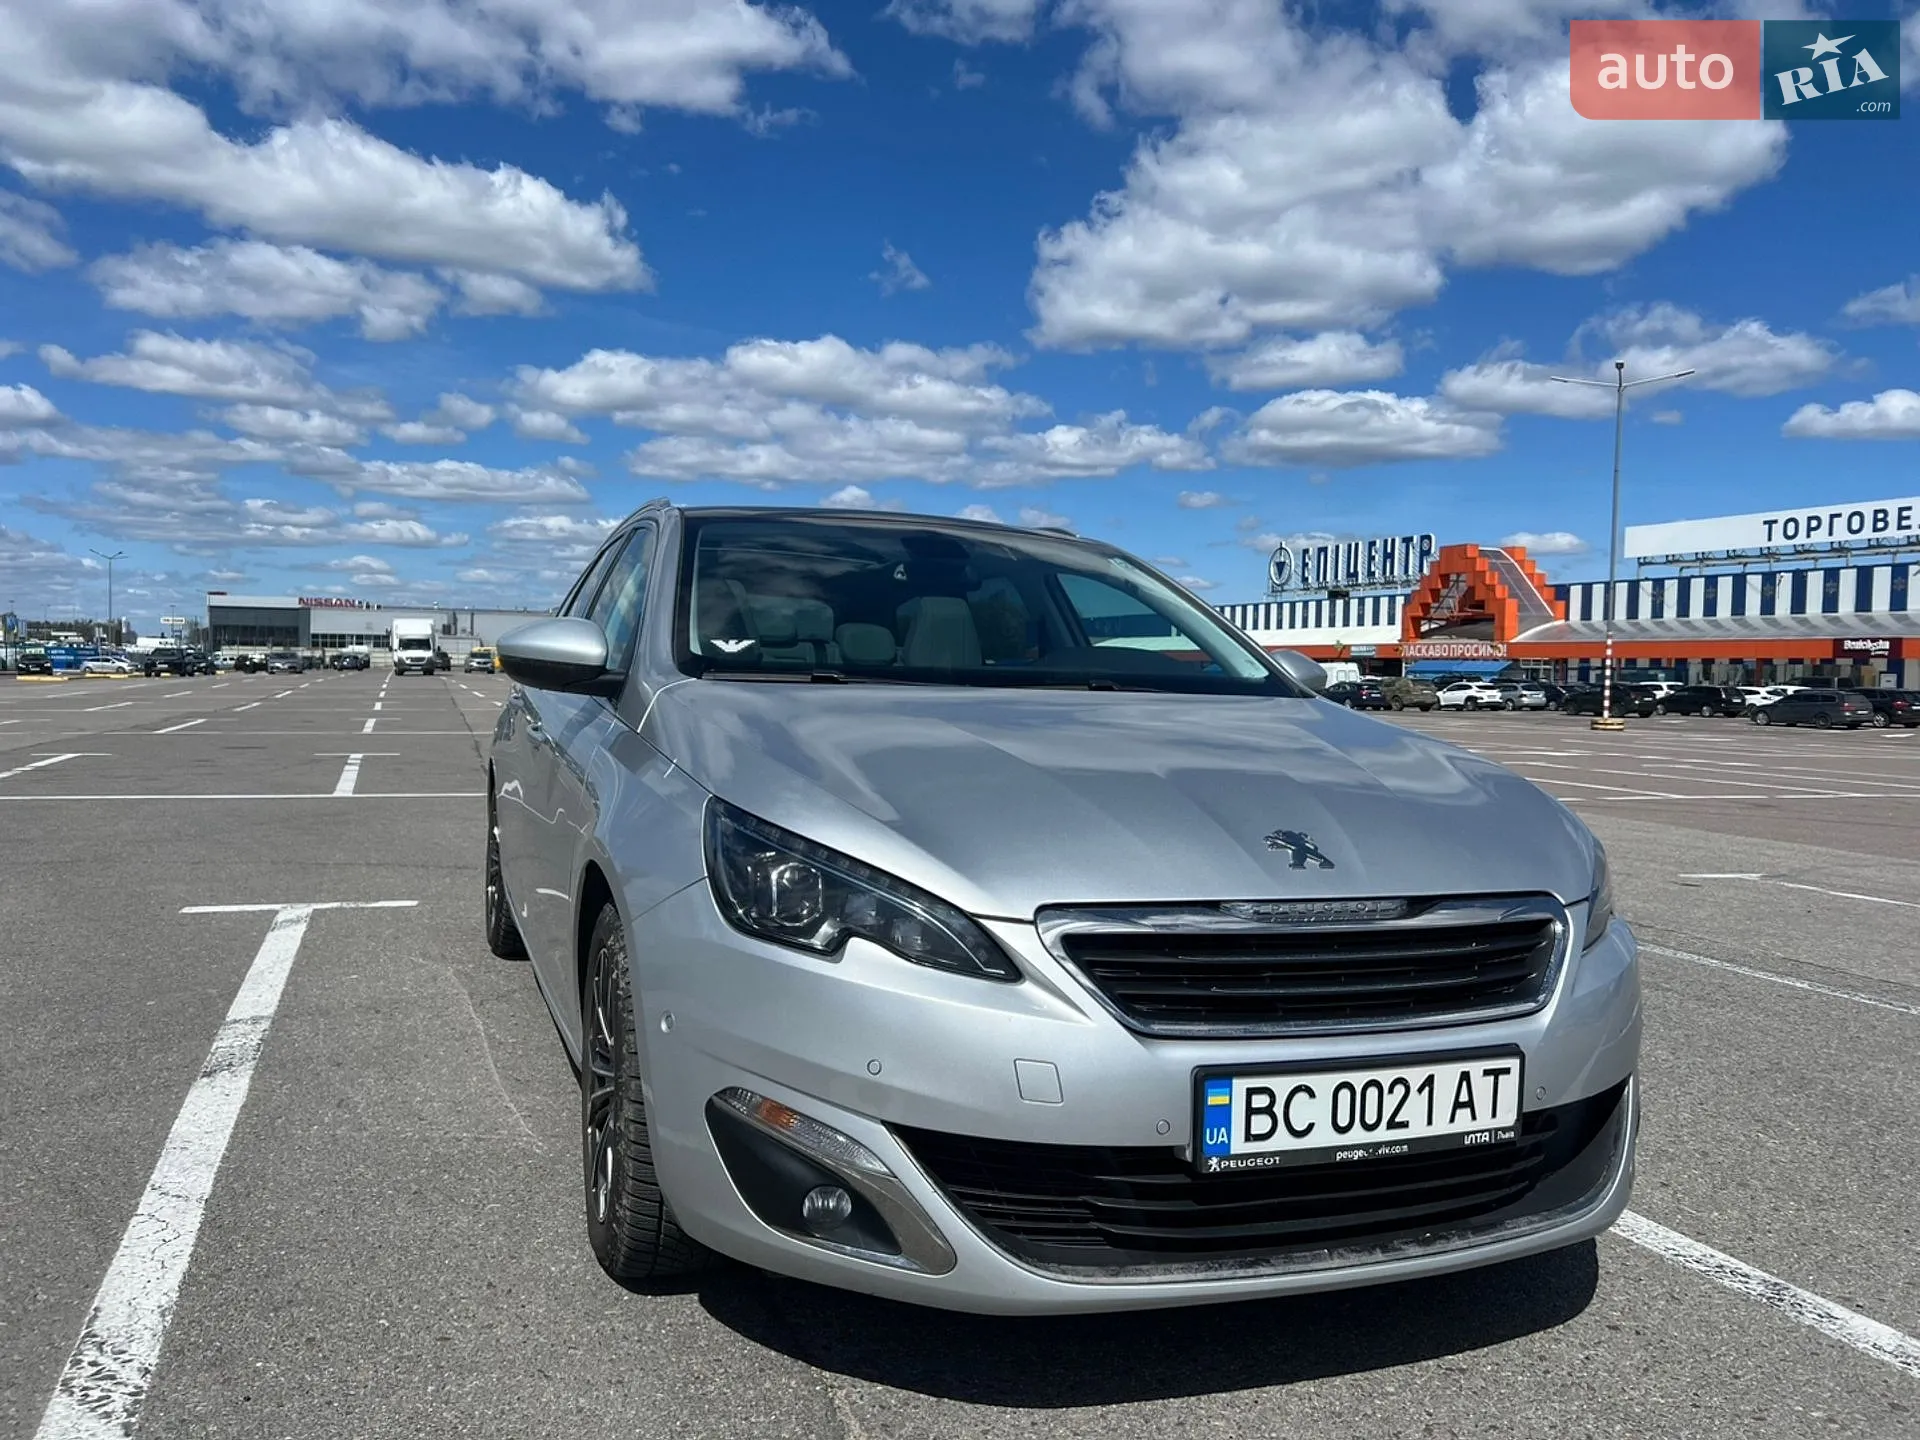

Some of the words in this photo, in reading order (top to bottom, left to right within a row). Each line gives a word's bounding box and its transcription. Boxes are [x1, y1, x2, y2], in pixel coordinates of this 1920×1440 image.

[1763, 505, 1920, 542] ТОРГОВЕ
[1301, 533, 1436, 585] ЕПІЦЕНТР
[298, 597, 355, 609] NISSAN
[1402, 644, 1448, 657] ЛАСКАВО
[1244, 1084, 1317, 1143] BC
[1330, 1073, 1436, 1135] 0021
[1448, 1066, 1511, 1124] AT
[1206, 1127, 1229, 1145] UA
[1221, 1156, 1281, 1168] PEUGEOT
